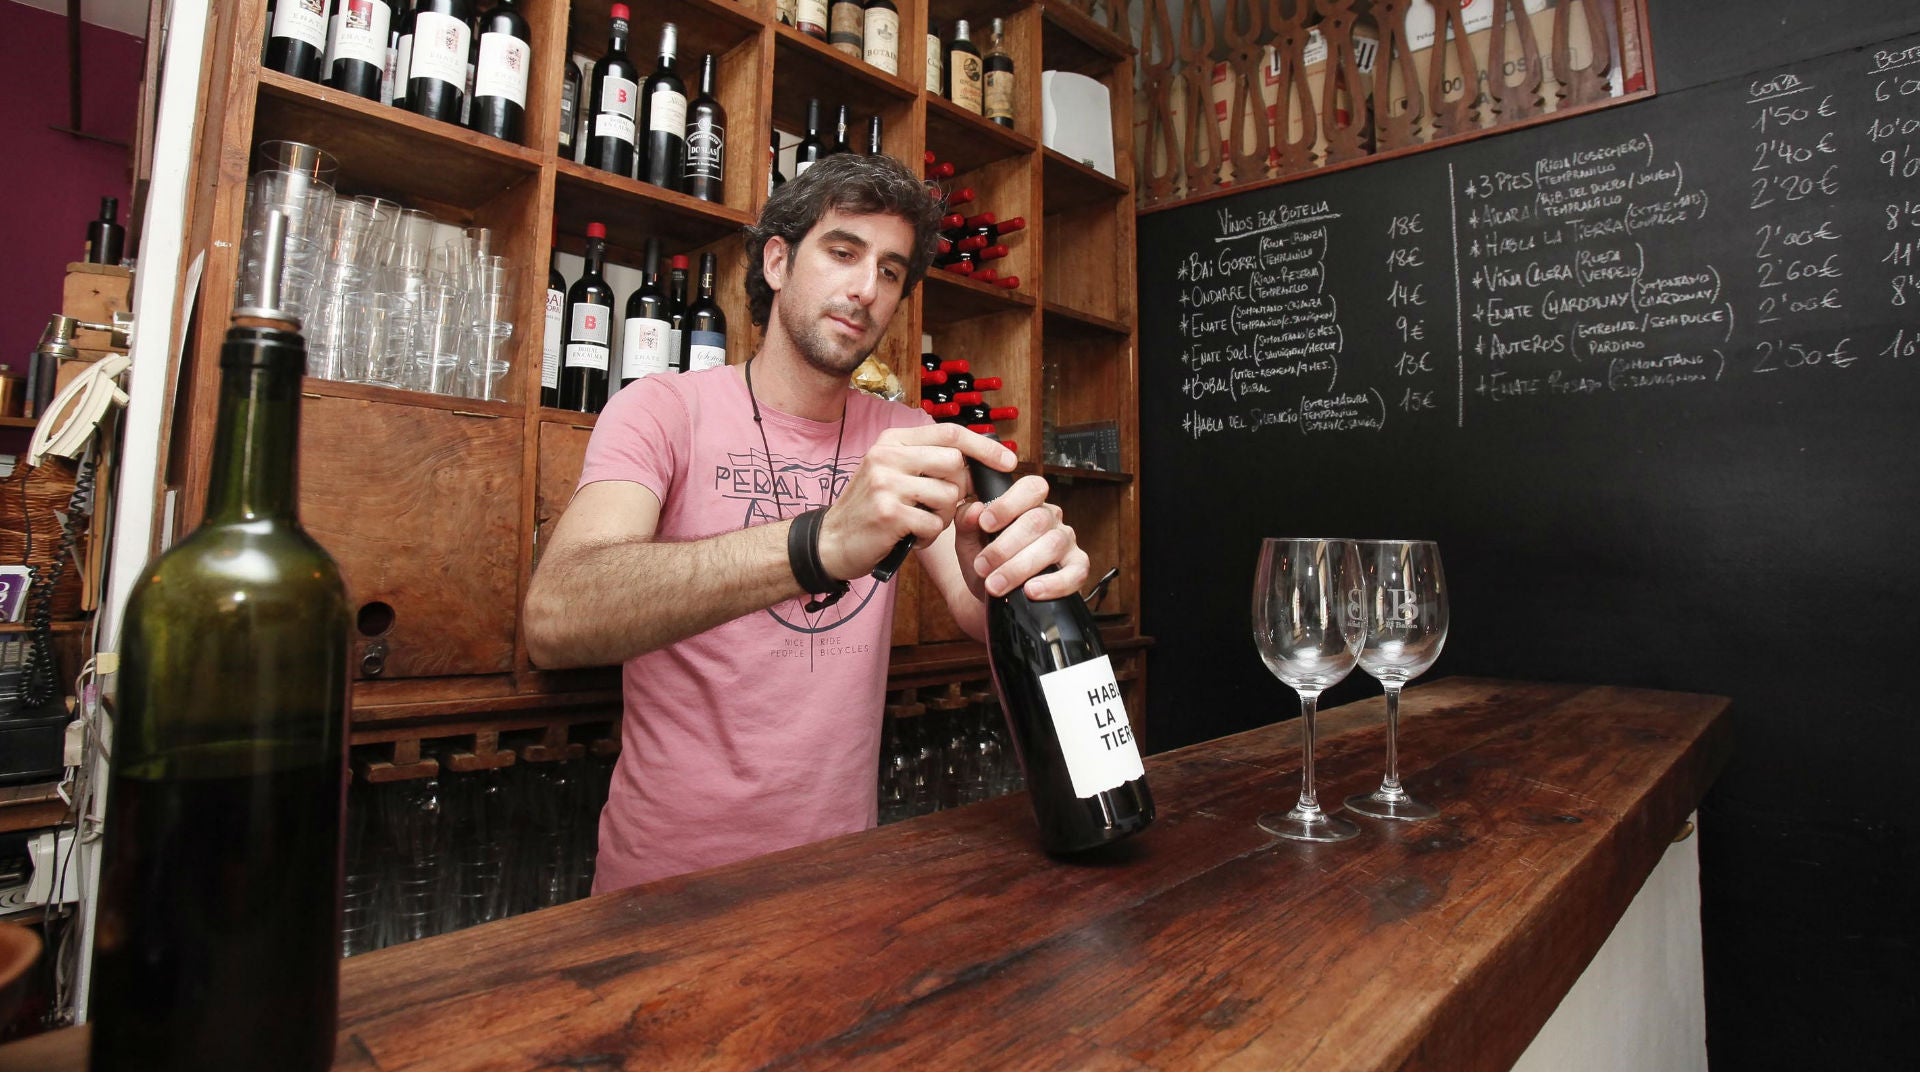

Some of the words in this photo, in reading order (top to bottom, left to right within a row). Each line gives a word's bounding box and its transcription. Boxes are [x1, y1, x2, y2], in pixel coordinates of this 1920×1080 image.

[585, 315, 597, 330] B
[715, 465, 809, 500] PEDAL
[784, 638, 804, 647] NICE
[820, 637, 841, 646] RIDE
[771, 649, 804, 658] PEOPLE
[820, 645, 870, 657] BICYCLES
[1094, 708, 1116, 729] LA
